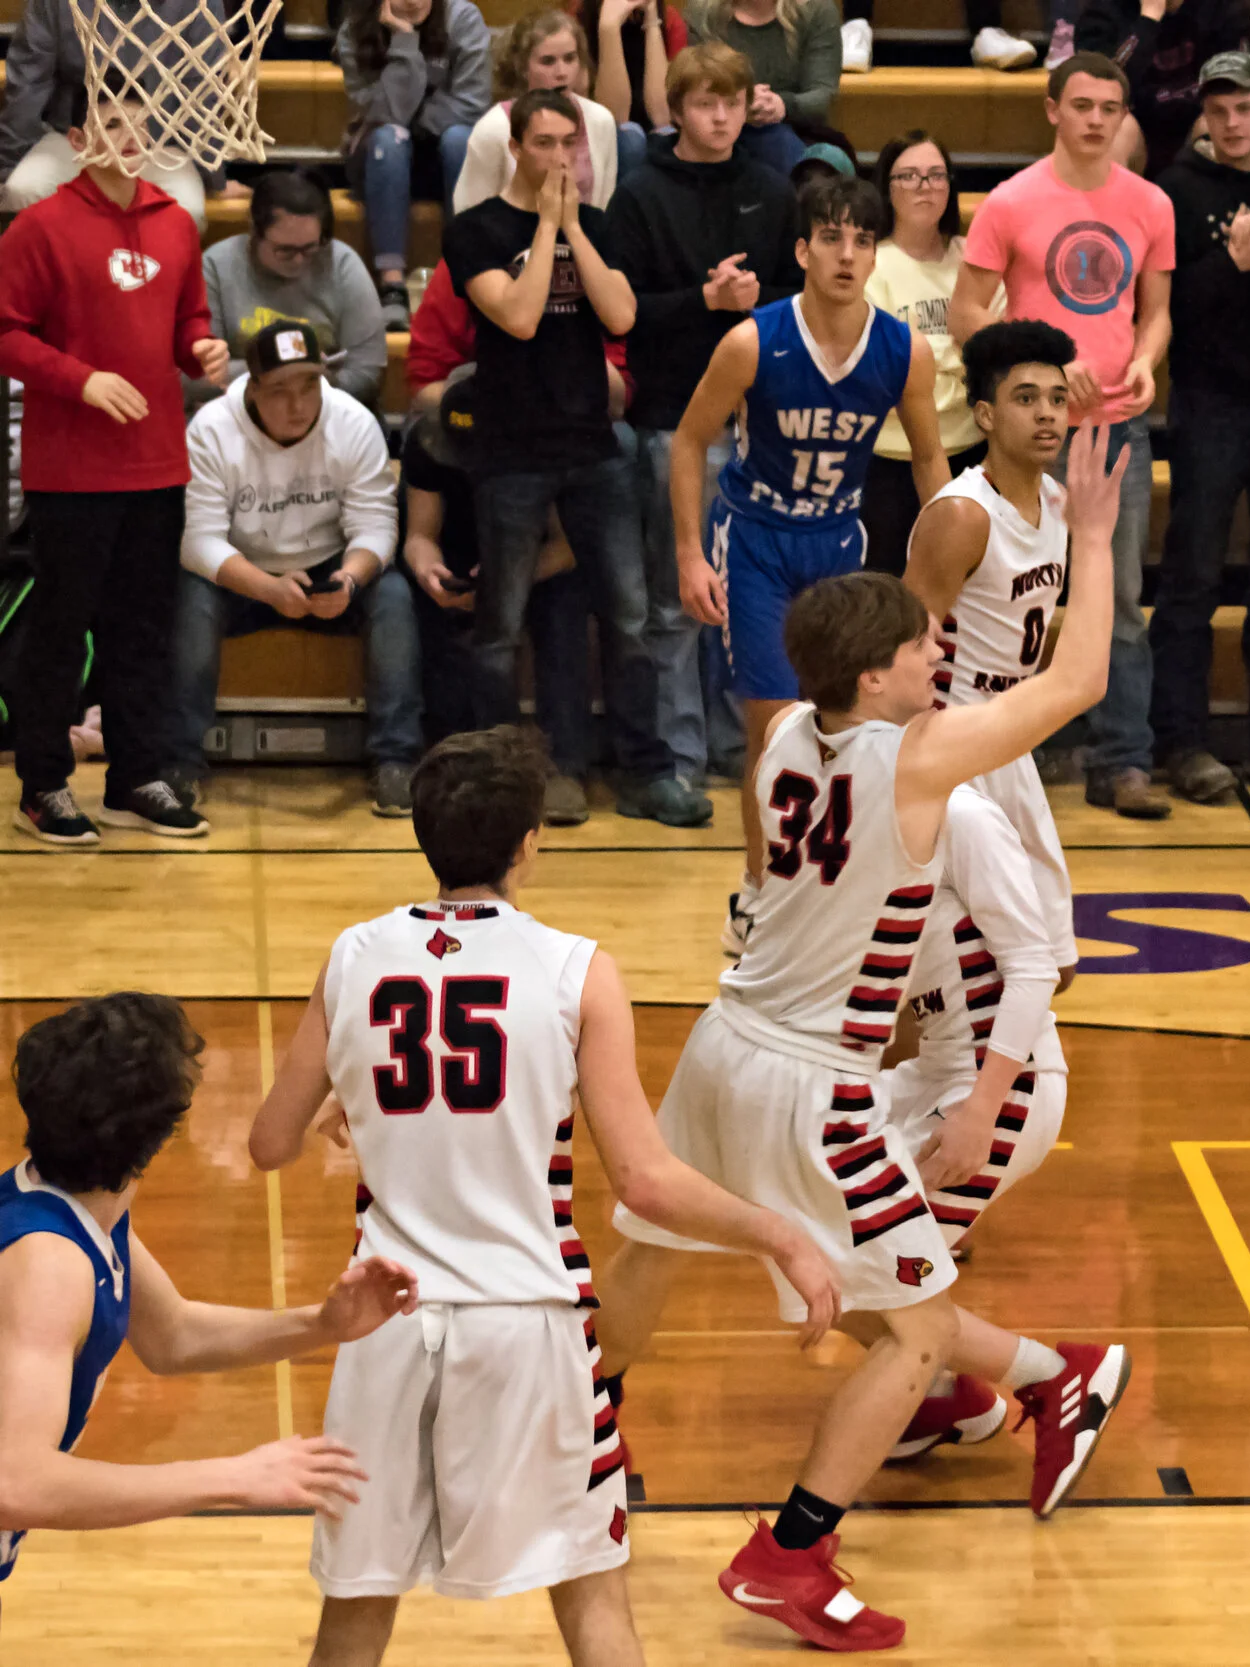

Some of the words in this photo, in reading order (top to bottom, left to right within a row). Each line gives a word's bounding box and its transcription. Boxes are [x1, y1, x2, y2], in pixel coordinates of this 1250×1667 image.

[777, 407, 878, 442] WEST
[791, 448, 848, 497] 15
[1019, 606, 1045, 666] 0
[767, 768, 853, 886] 34
[369, 975, 510, 1115] 35
